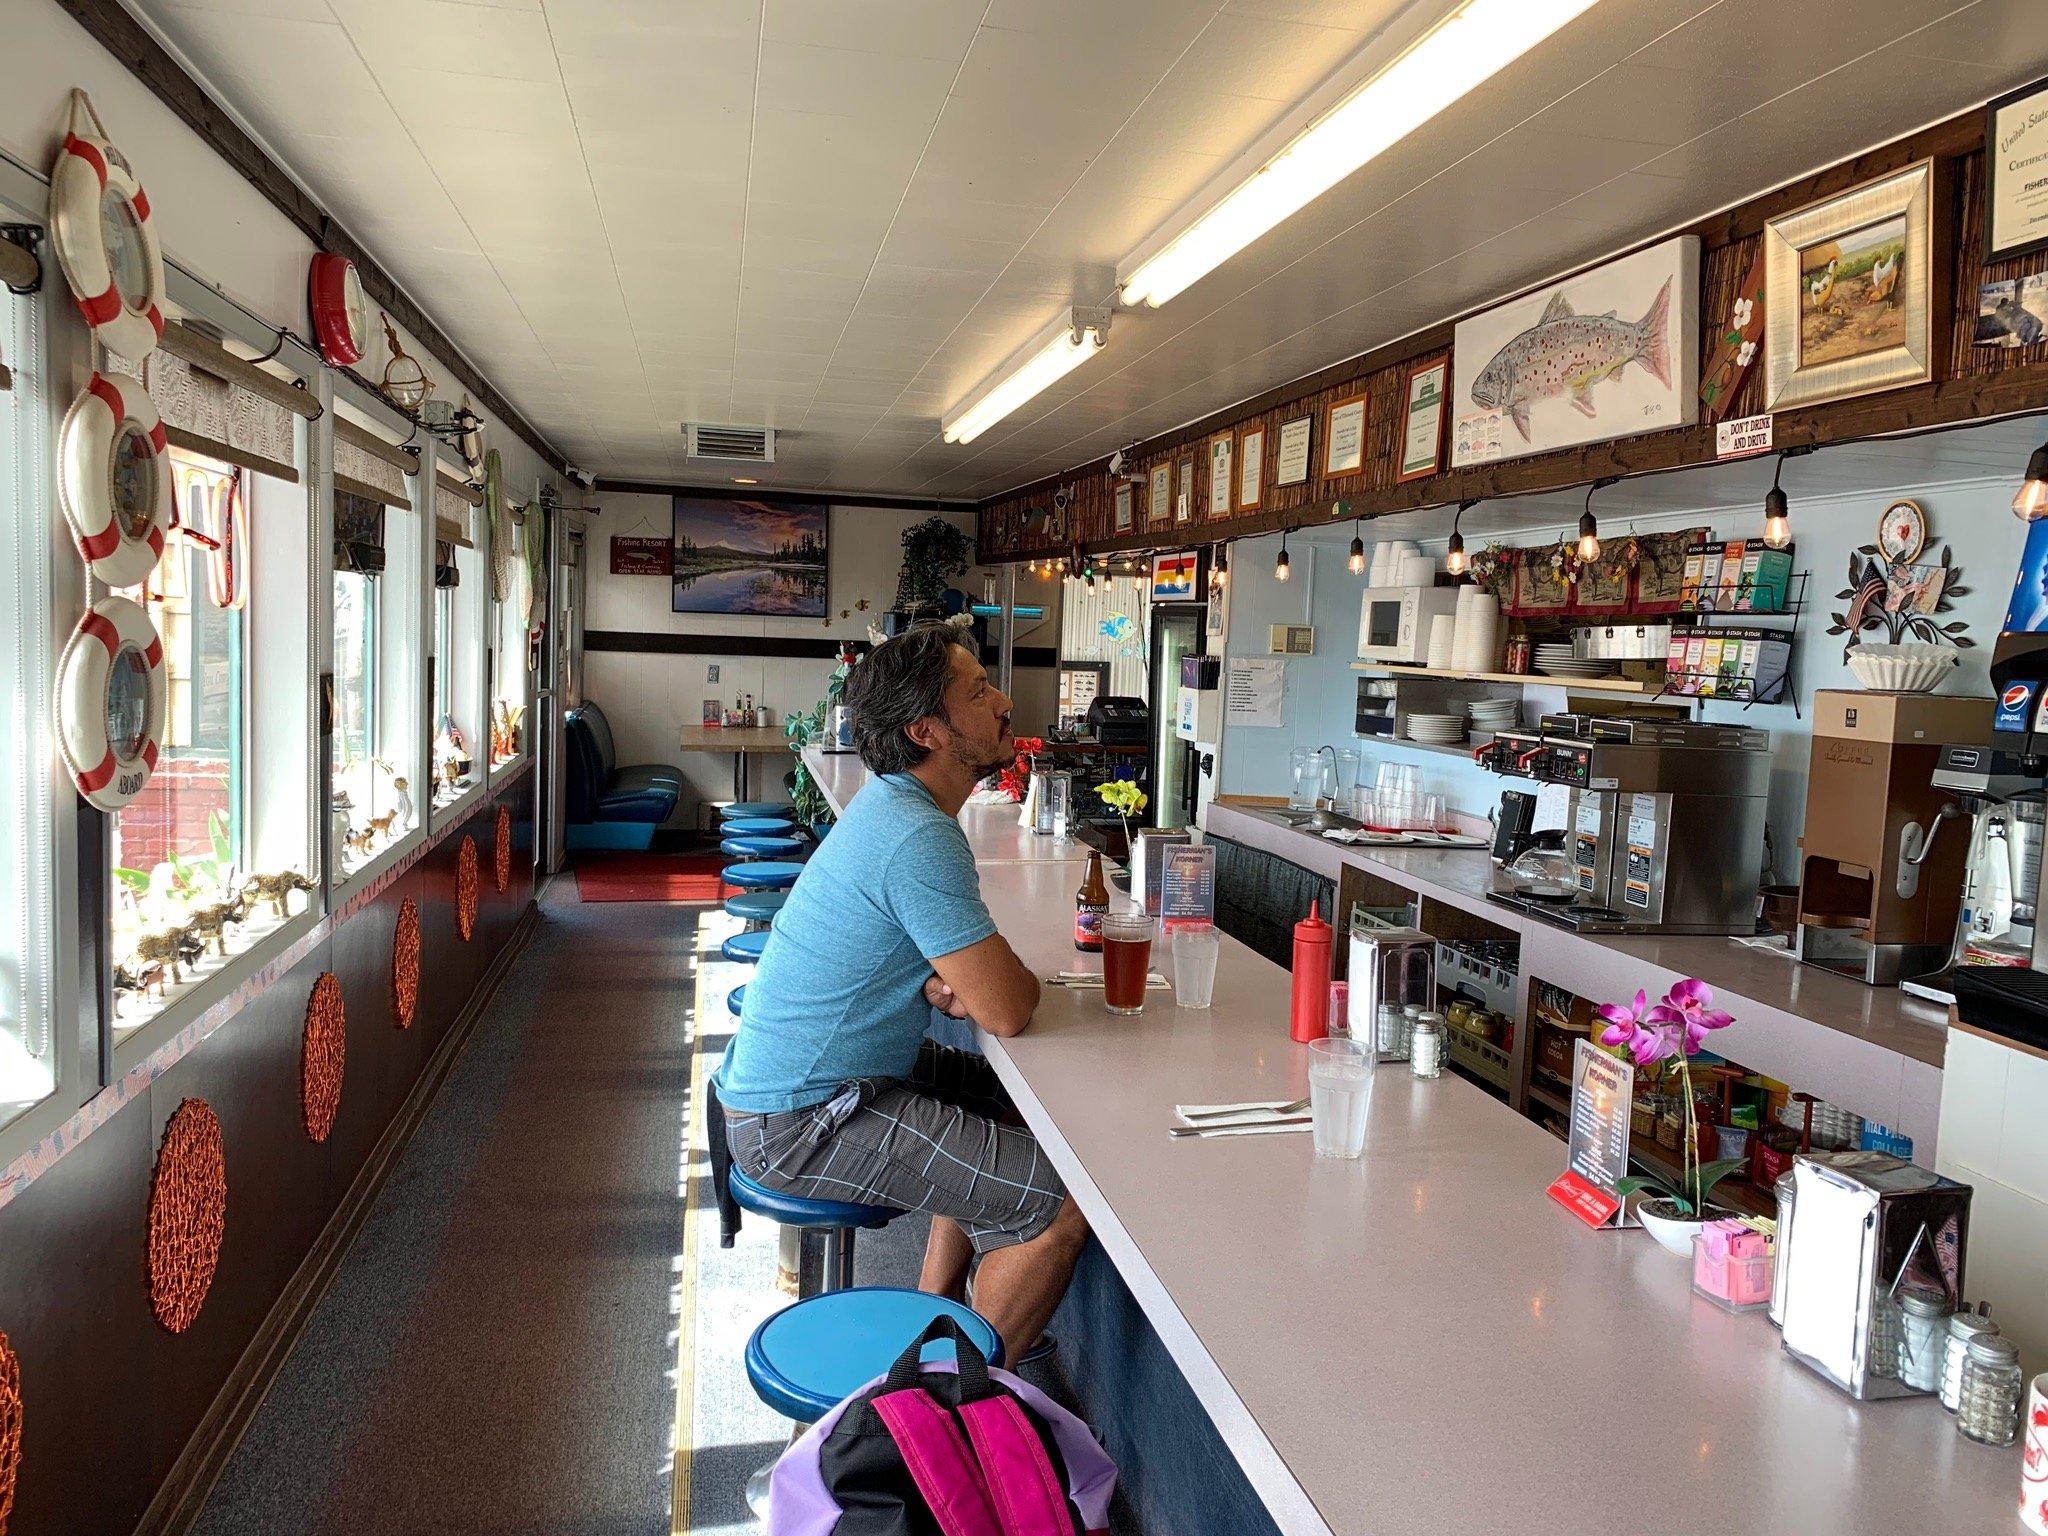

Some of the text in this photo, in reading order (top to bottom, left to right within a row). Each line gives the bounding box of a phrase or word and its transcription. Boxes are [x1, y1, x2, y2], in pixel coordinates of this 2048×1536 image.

[2001, 122, 2025, 153] United
[1730, 417, 1770, 435] DON'T DRINK
[1734, 433, 1767, 450] AND DRIVE
[643, 539, 667, 548] RESORT
[1769, 632, 1786, 640] STASH
[2000, 713, 2021, 722] pepsi
[1556, 748, 1573, 757] BUNN
[117, 771, 143, 795] ABOARD
[1167, 846, 1212, 855] FISHERMAN'S
[1175, 856, 1203, 864] KORNER
[1550, 1040, 1561, 1050] HOT
[1547, 1048, 1563, 1061] COCOA
[1581, 1046, 1629, 1082] FISHERMAN'S
[1588, 1067, 1617, 1093] KORNER
